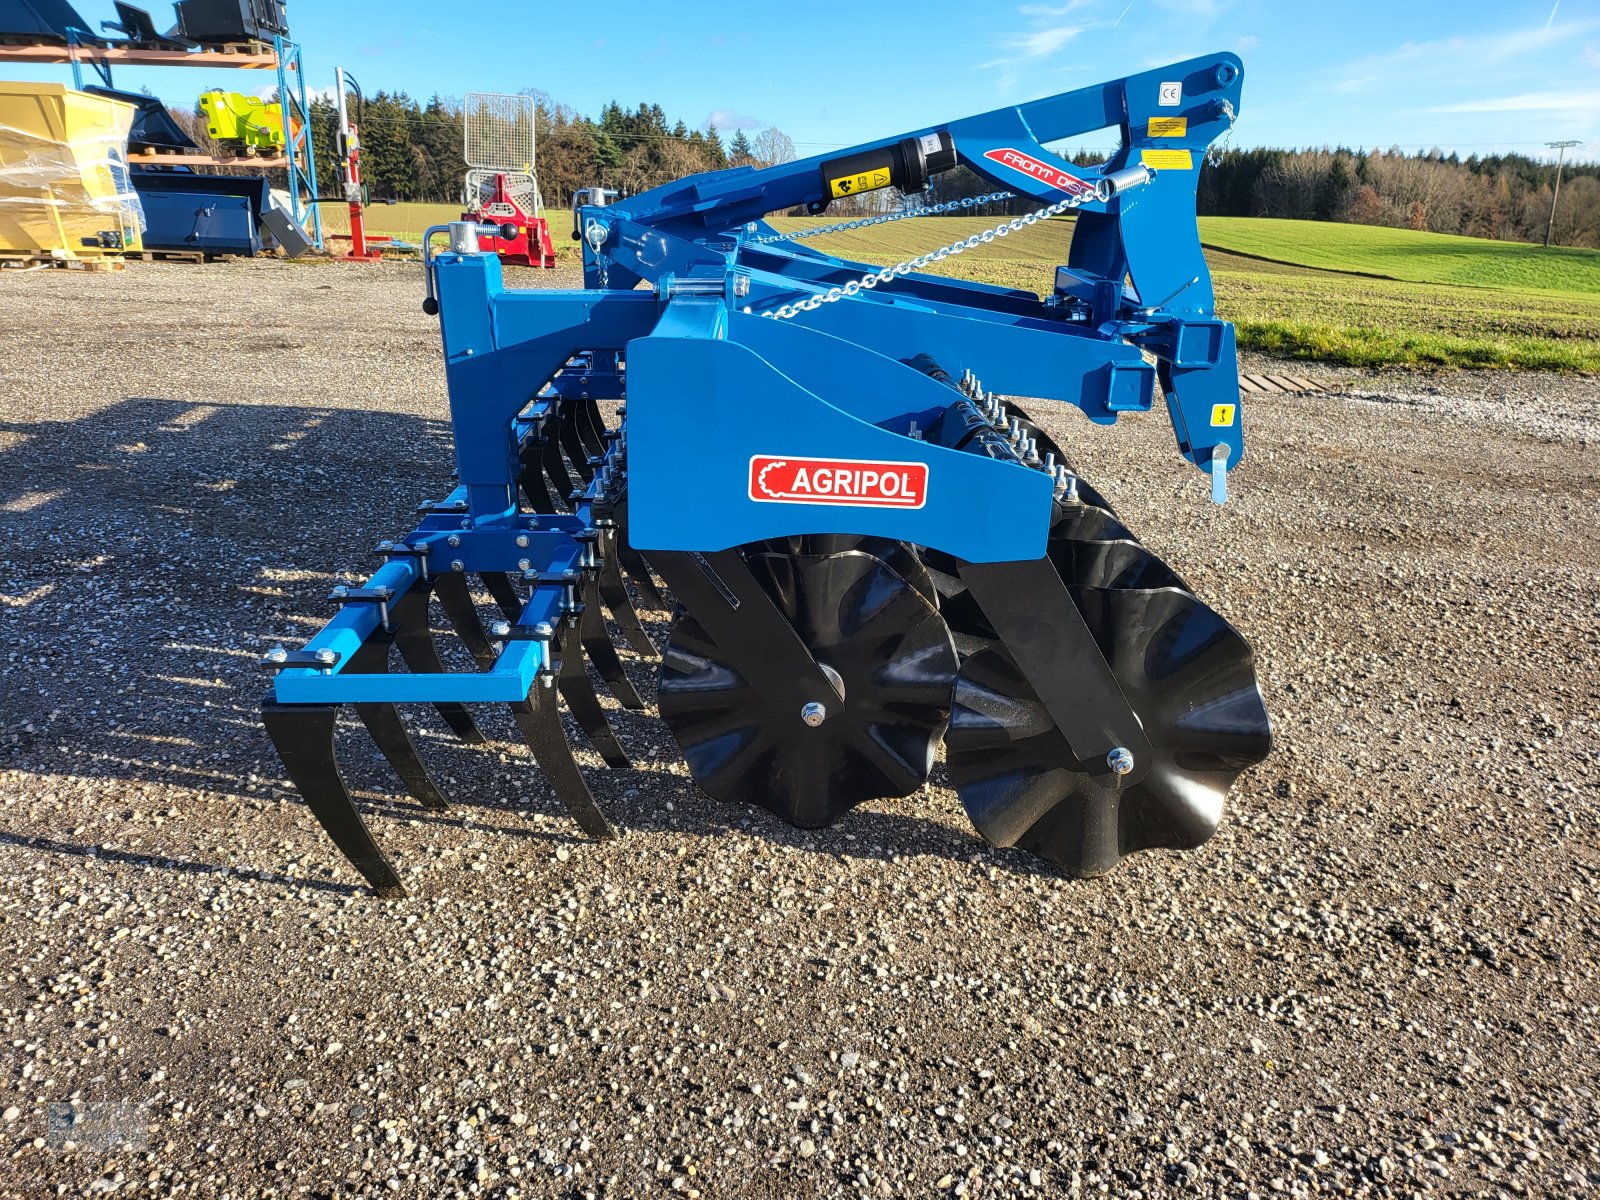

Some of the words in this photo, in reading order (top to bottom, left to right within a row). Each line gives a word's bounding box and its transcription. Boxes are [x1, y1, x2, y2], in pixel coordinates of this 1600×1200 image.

[1163, 88, 1177, 99] CE
[1003, 151, 1054, 179] FRONT
[791, 467, 916, 497] AGRIPOL
